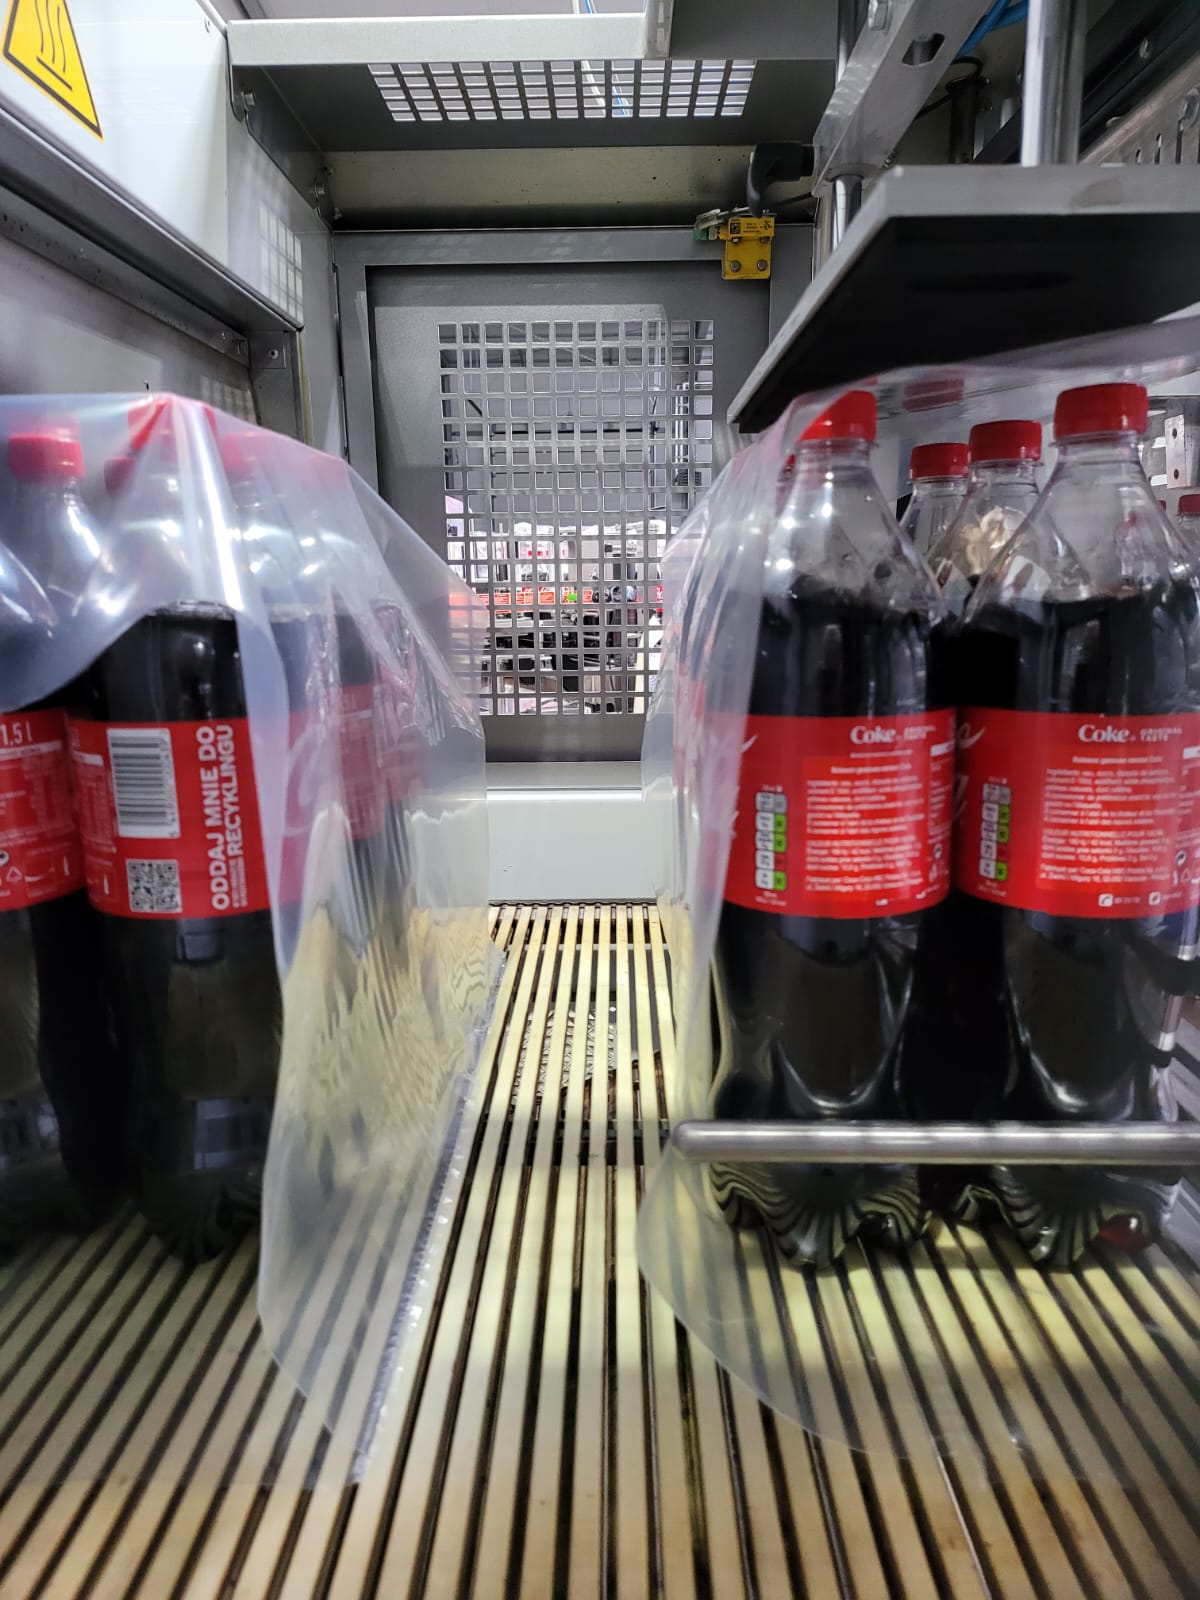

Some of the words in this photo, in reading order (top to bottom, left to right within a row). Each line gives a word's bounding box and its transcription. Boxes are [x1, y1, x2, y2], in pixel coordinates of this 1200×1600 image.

[196, 726, 216, 762] DO
[850, 725, 897, 744] Coke
[1078, 724, 1130, 742] Coke
[200, 766, 222, 827] MNIE
[216, 725, 244, 857] RECYKLINGU
[206, 832, 230, 910] ODDAJ
